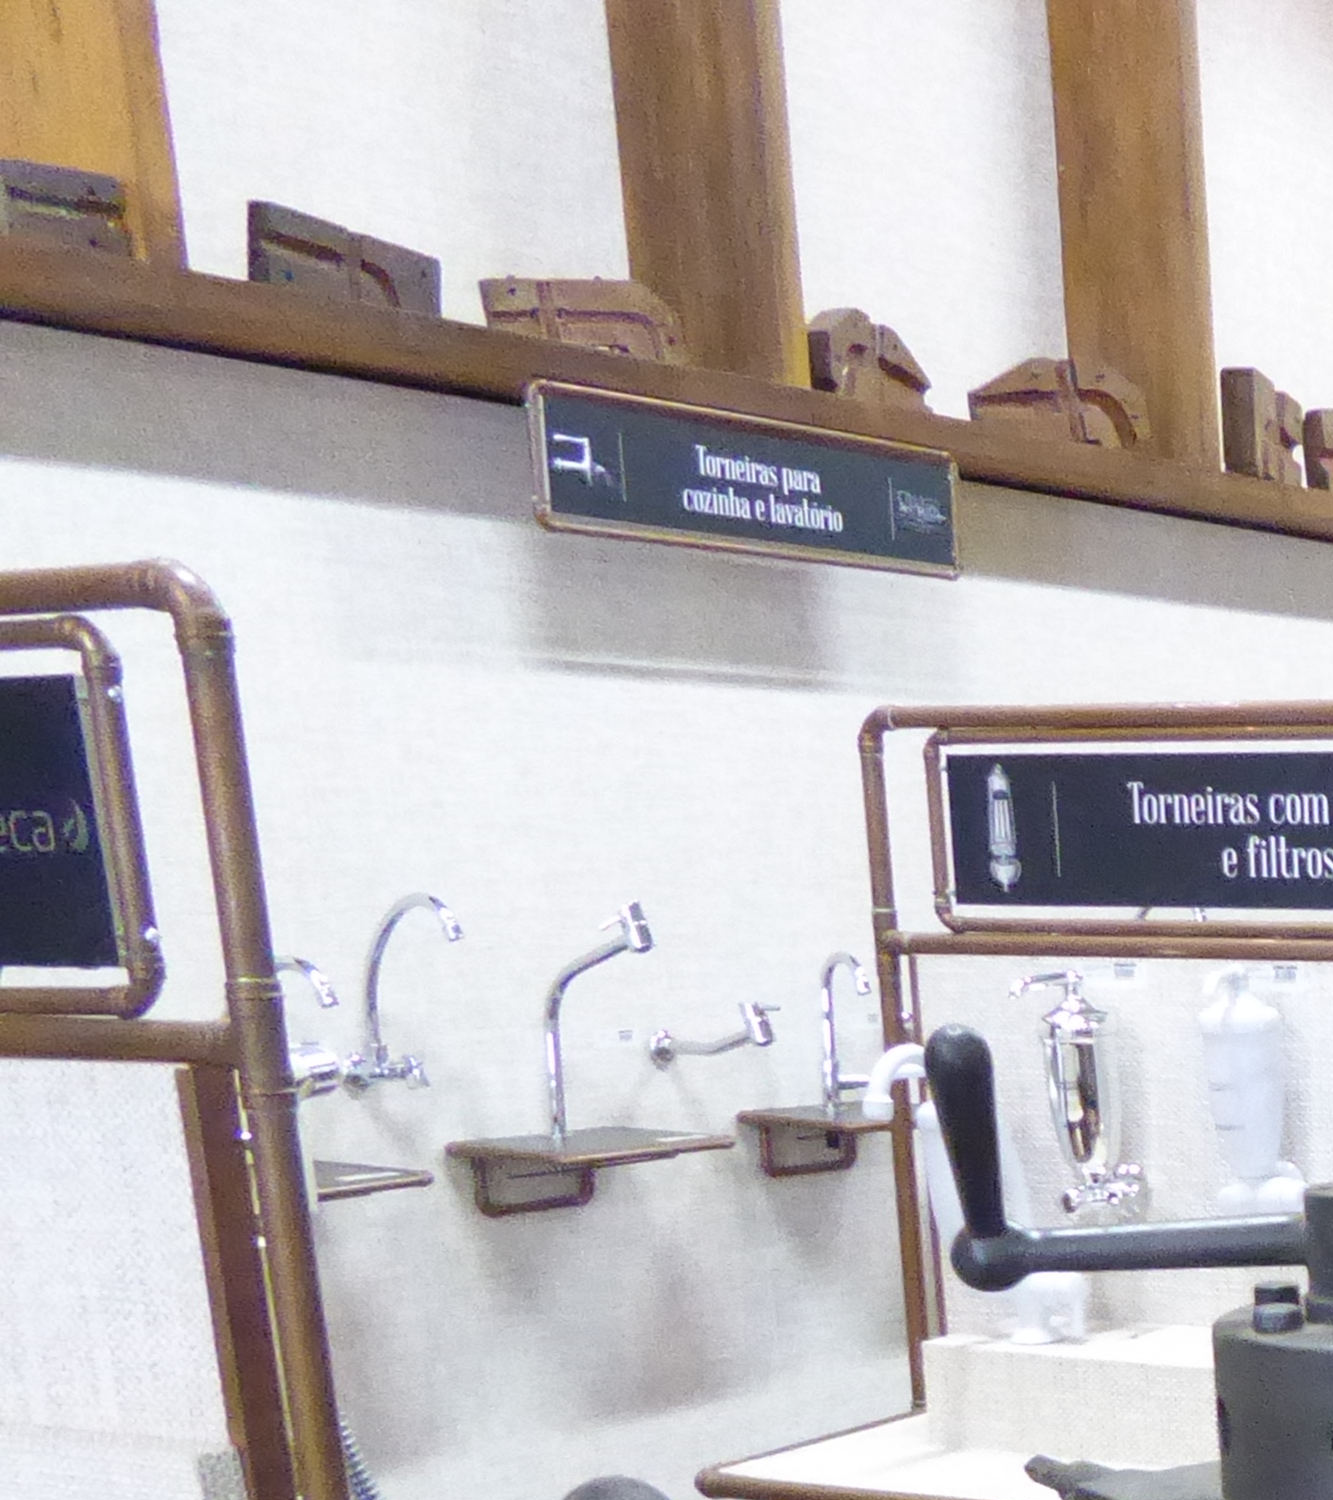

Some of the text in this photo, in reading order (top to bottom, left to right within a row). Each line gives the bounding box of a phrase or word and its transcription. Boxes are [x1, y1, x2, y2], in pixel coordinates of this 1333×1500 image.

[694, 443, 821, 495] Torneiras para
[682, 487, 844, 533] cozinha e lavatório
[1127, 781, 1260, 825] Torneiras
[1268, 792, 1331, 825] com
[1222, 845, 1239, 879] e
